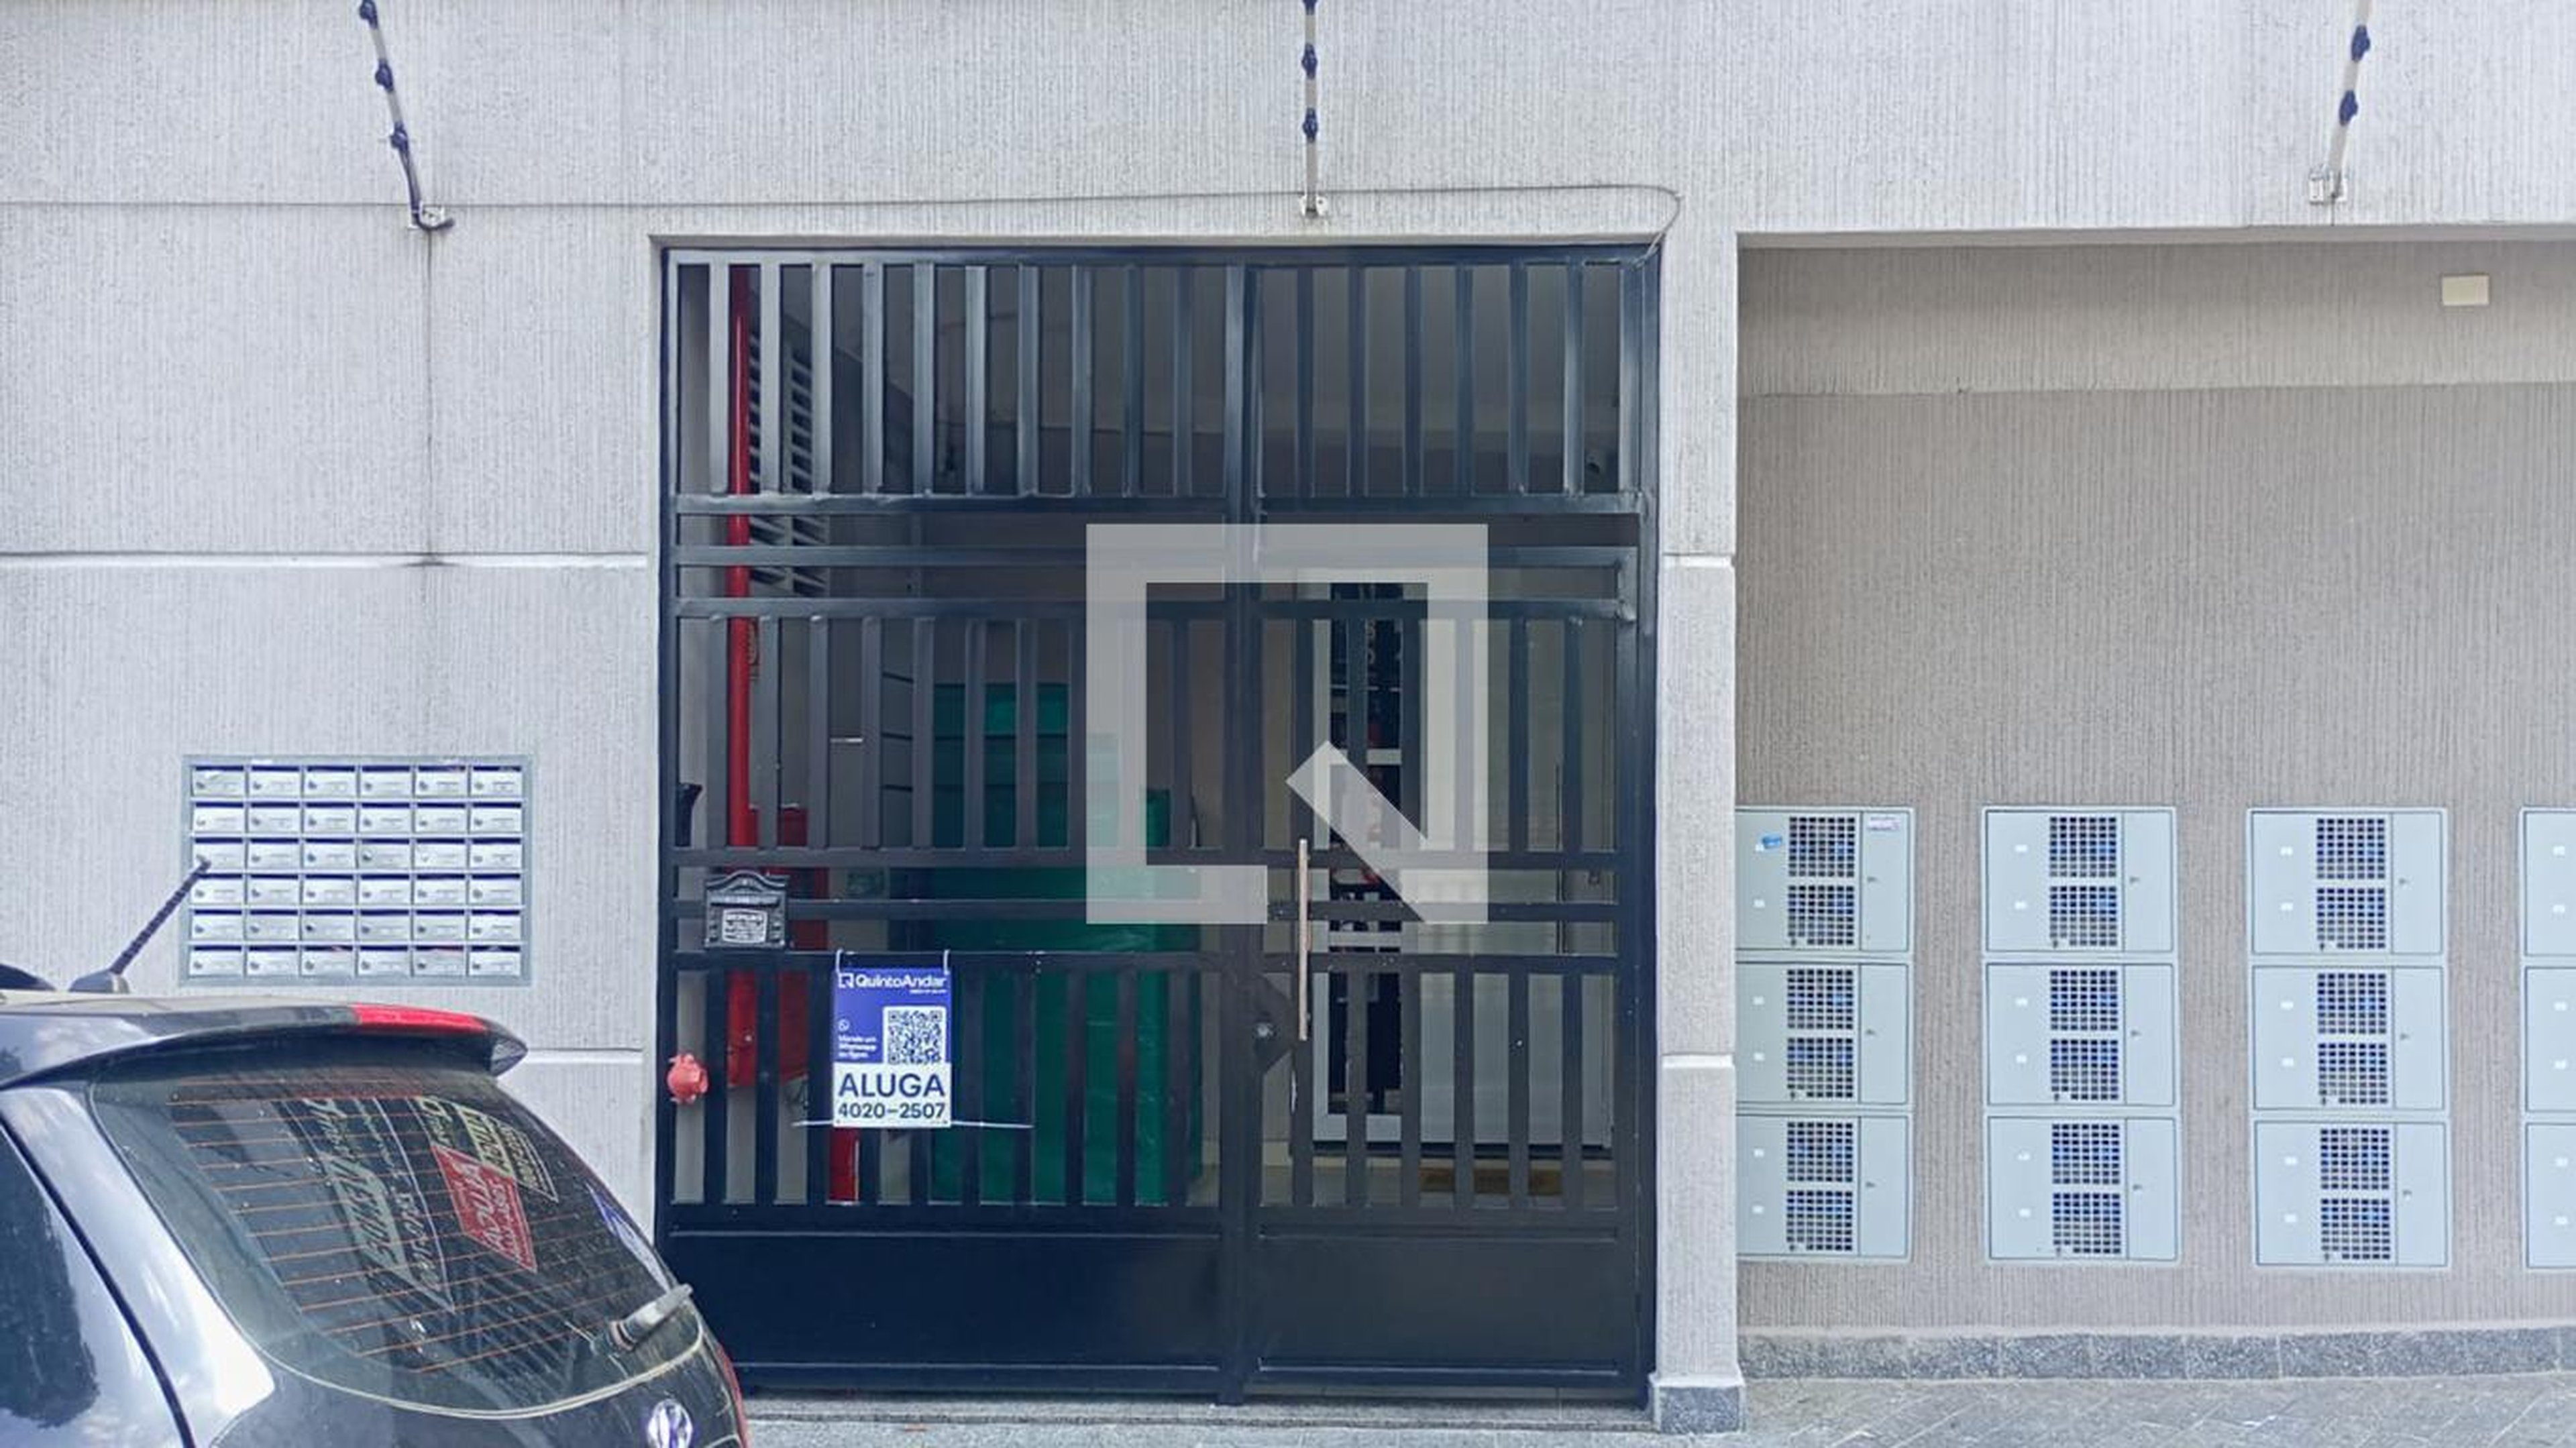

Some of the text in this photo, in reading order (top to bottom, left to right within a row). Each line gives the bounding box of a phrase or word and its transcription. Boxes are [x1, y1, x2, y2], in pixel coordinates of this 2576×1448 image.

[856, 974, 946, 988] QuintoAndar
[839, 1073, 945, 1098] ALUGA
[839, 1103, 946, 1119] 4020-2507
